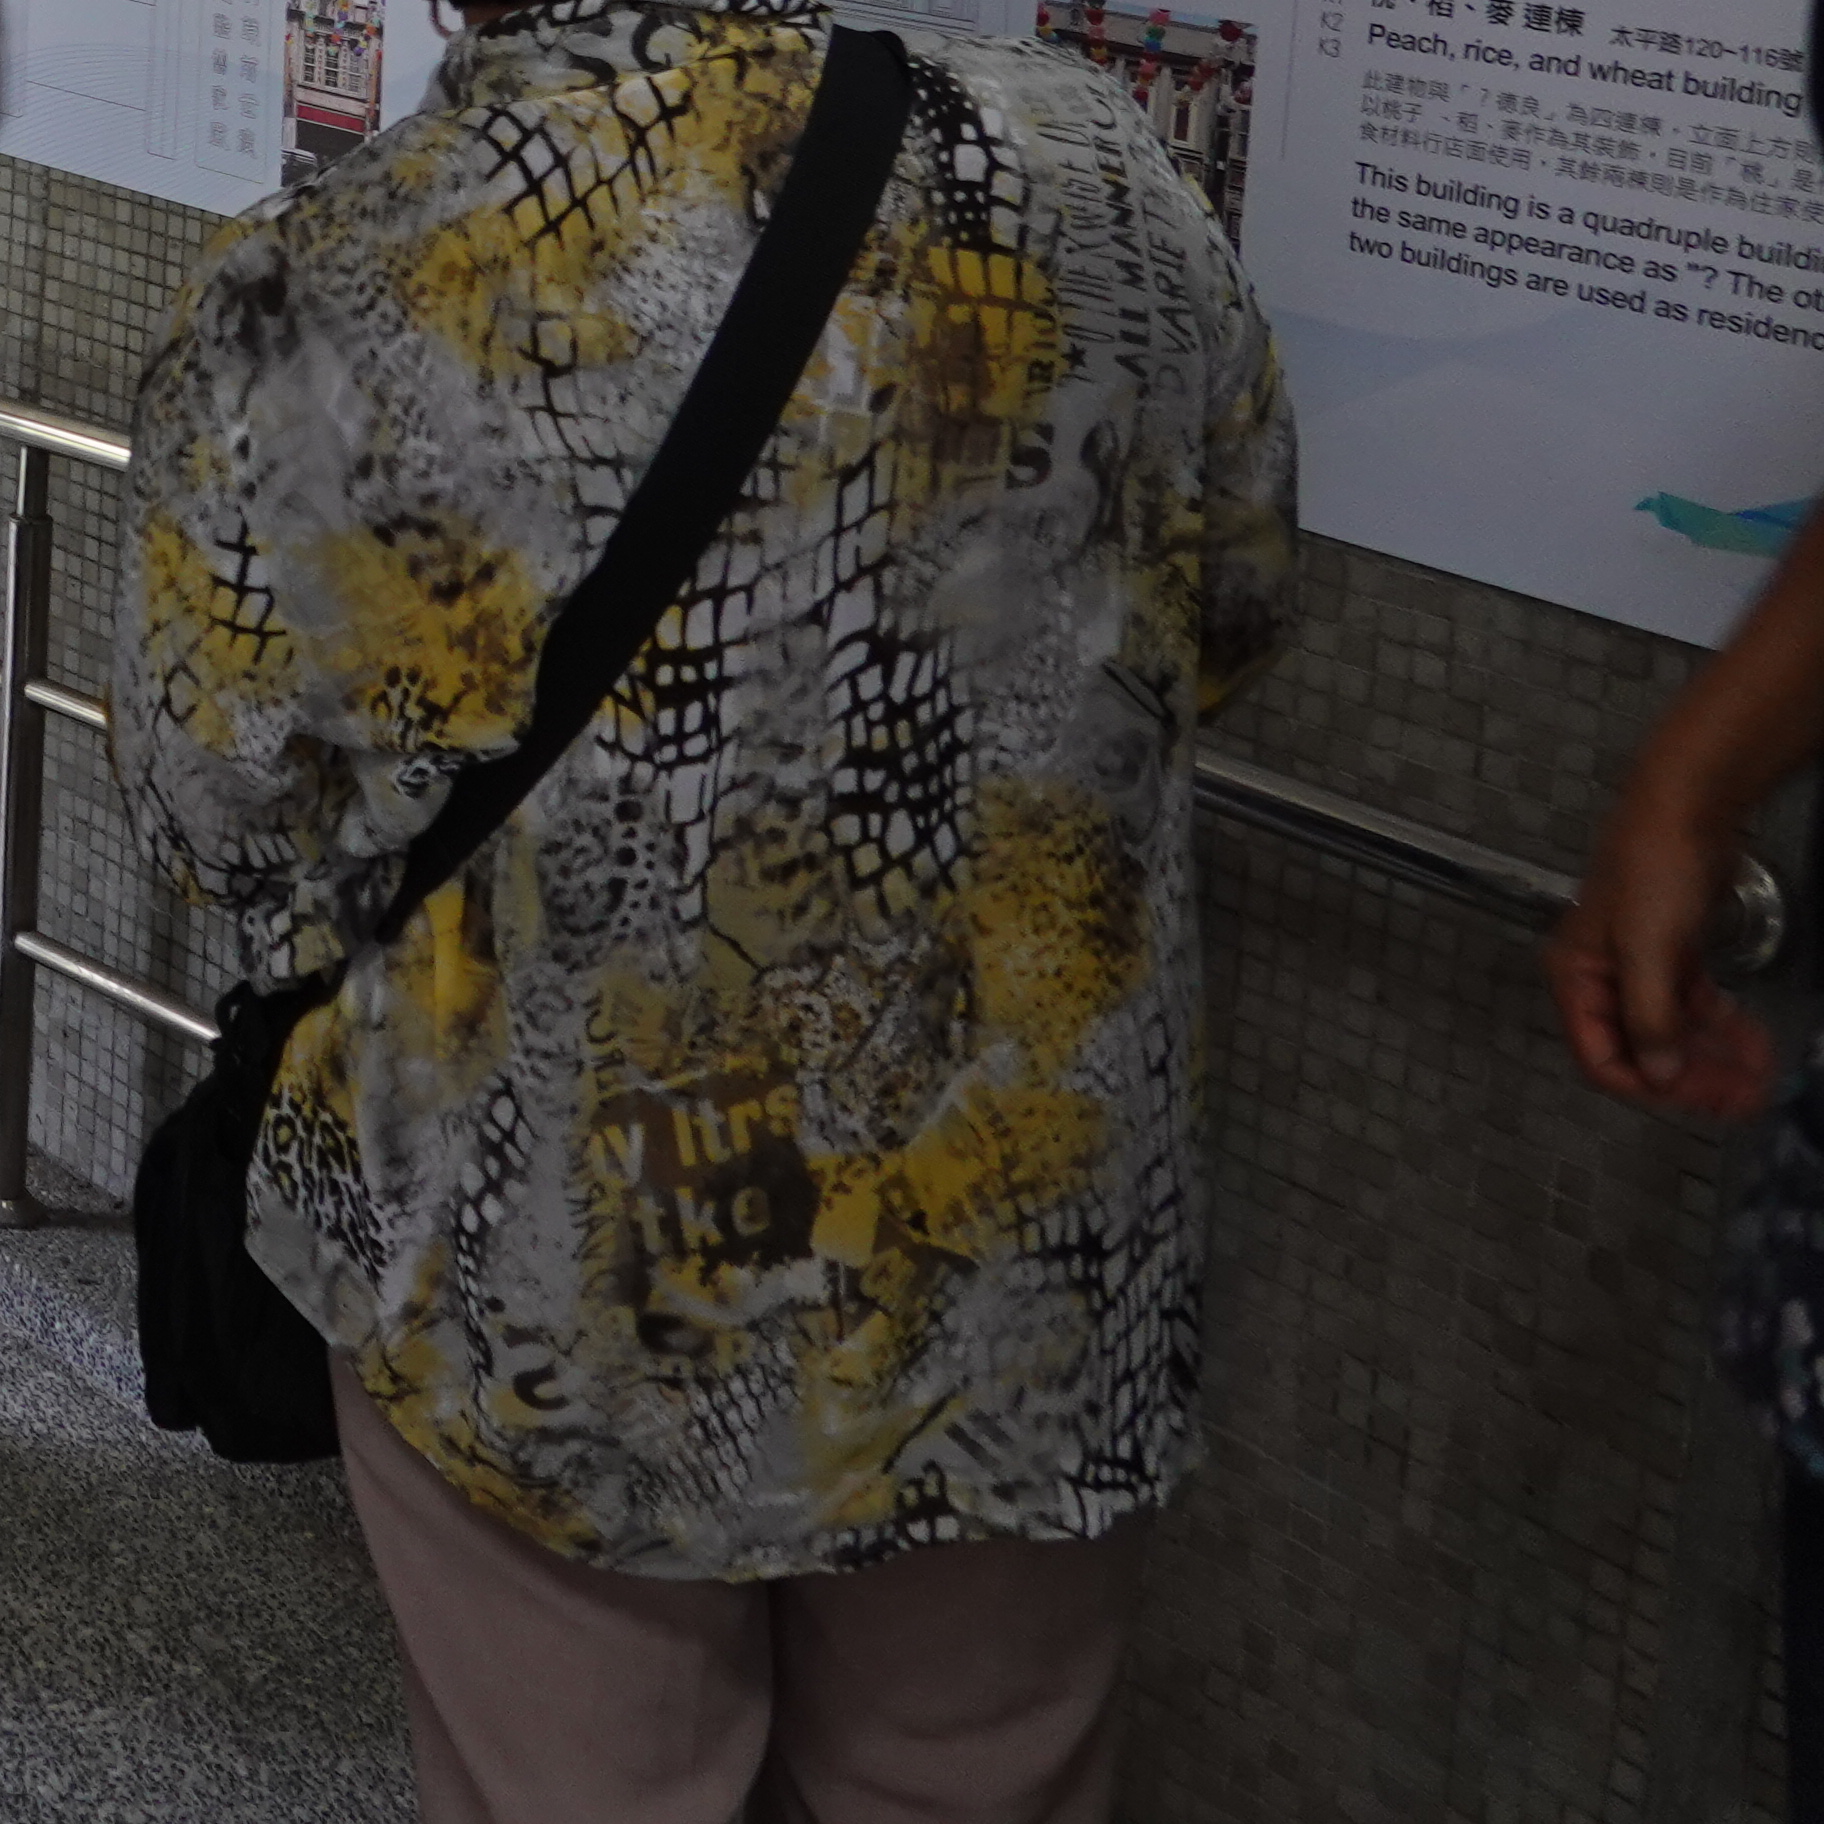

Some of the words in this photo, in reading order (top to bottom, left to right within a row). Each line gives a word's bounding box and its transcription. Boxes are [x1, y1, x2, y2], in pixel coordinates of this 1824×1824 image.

[1318, 37, 1342, 58] K3
[1320, 11, 1344, 31] K2
[1524, 3, 1586, 37] 連棟
[1368, 22, 1454, 61] Peach,
[1464, 37, 1520, 71] rice,
[1529, 55, 1581, 77] and
[1587, 59, 1674, 93] wheat
[1683, 70, 1803, 118] building
[1352, 196, 1390, 224] the
[1396, 209, 1468, 239] same
[1474, 226, 1635, 275] appearance
[1642, 259, 1678, 283] as
[1728, 269, 1783, 304] The
[1355, 161, 1408, 193] This
[1415, 173, 1519, 219] building
[1527, 194, 1550, 220] is
[1557, 204, 1574, 225] a
[1582, 209, 1728, 254] quadruple
[1349, 231, 1393, 261] two
[1399, 240, 1519, 289] buildings
[1526, 274, 1569, 298] are
[1577, 280, 1647, 315] used
[1654, 300, 1689, 323] as
